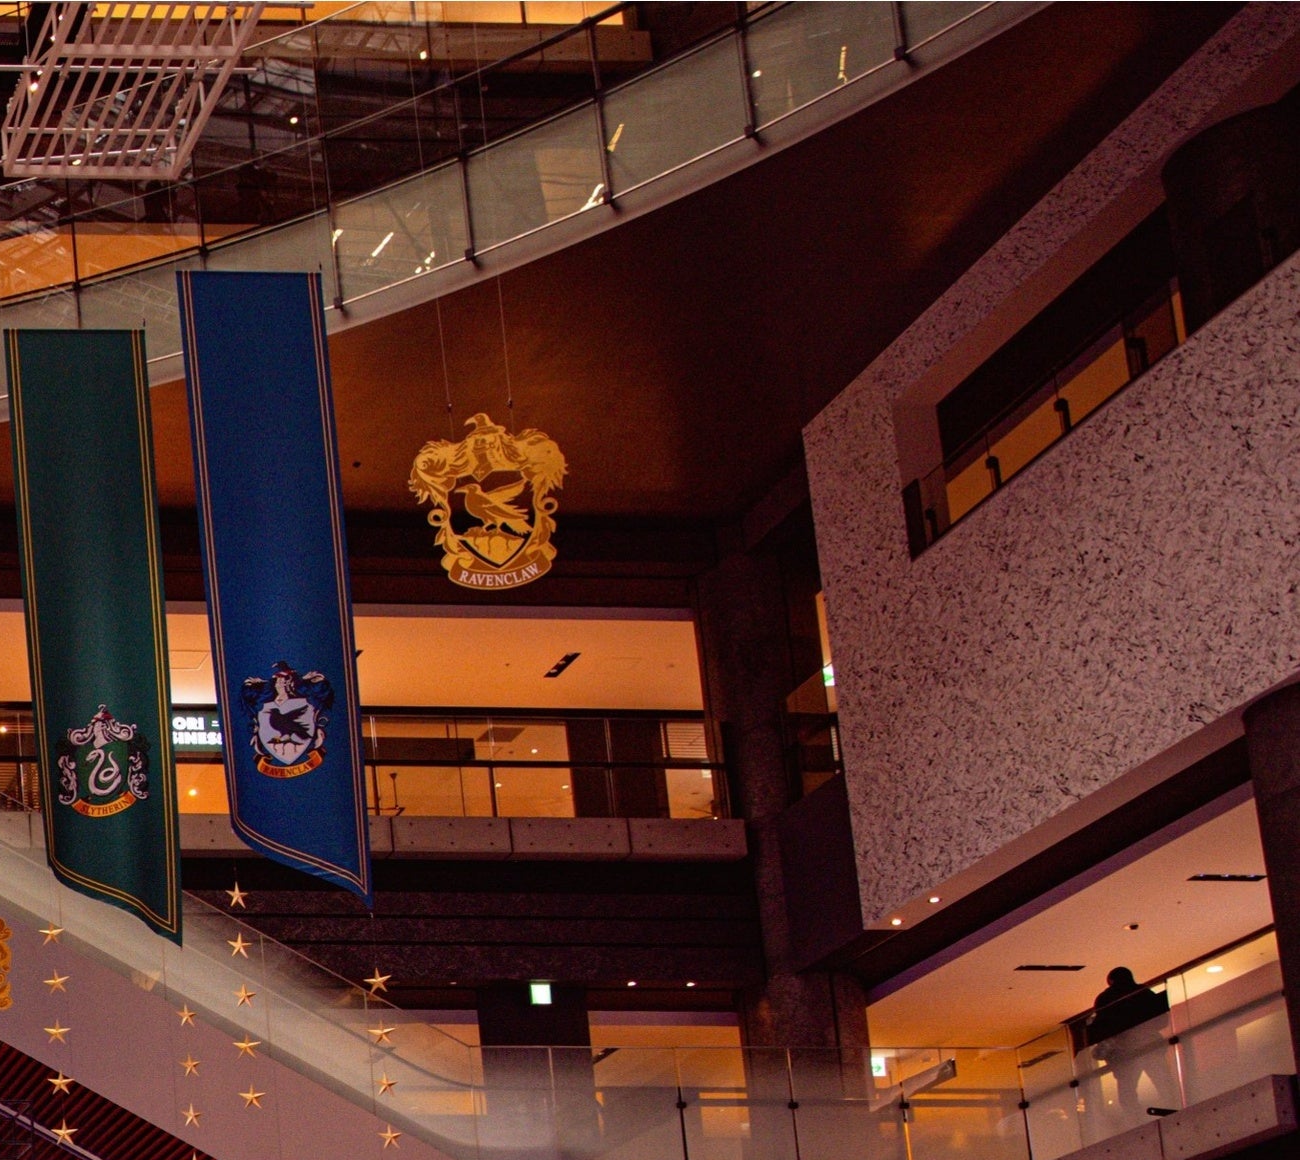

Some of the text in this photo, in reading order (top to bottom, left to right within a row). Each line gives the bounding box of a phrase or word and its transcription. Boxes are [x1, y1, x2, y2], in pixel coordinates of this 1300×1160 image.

[458, 563, 540, 587] RAVENCLAW
[263, 760, 318, 778] RAVENCLAW
[80, 798, 132, 818] SLYTHERIN
